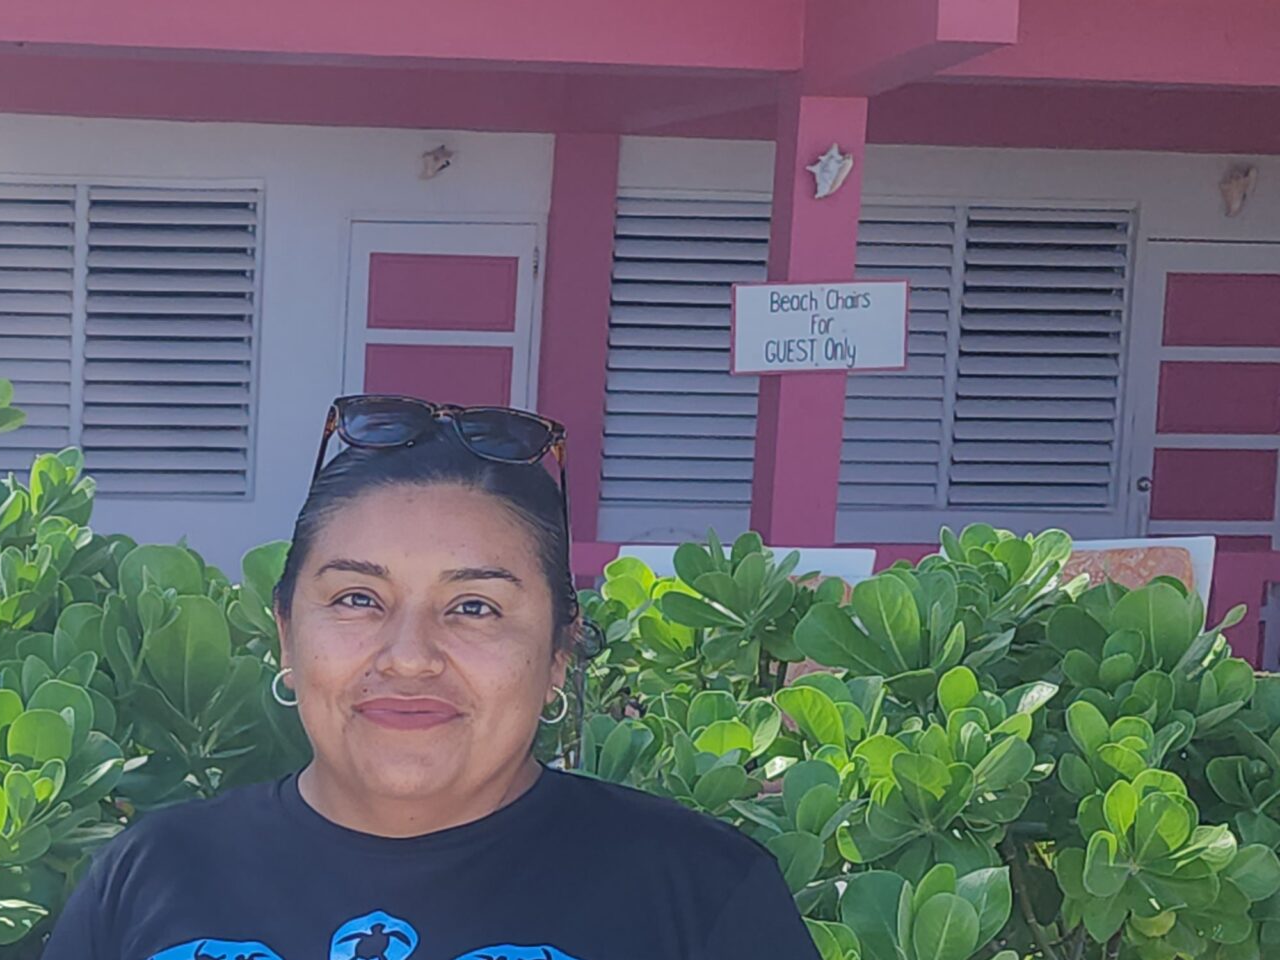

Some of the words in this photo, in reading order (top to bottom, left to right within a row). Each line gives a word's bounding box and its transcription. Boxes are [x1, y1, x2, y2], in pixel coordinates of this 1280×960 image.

[769, 291, 818, 313] Beach
[826, 289, 871, 310] Chairs
[811, 314, 835, 335] For
[765, 338, 817, 363] GUEST
[824, 337, 856, 369] Only
